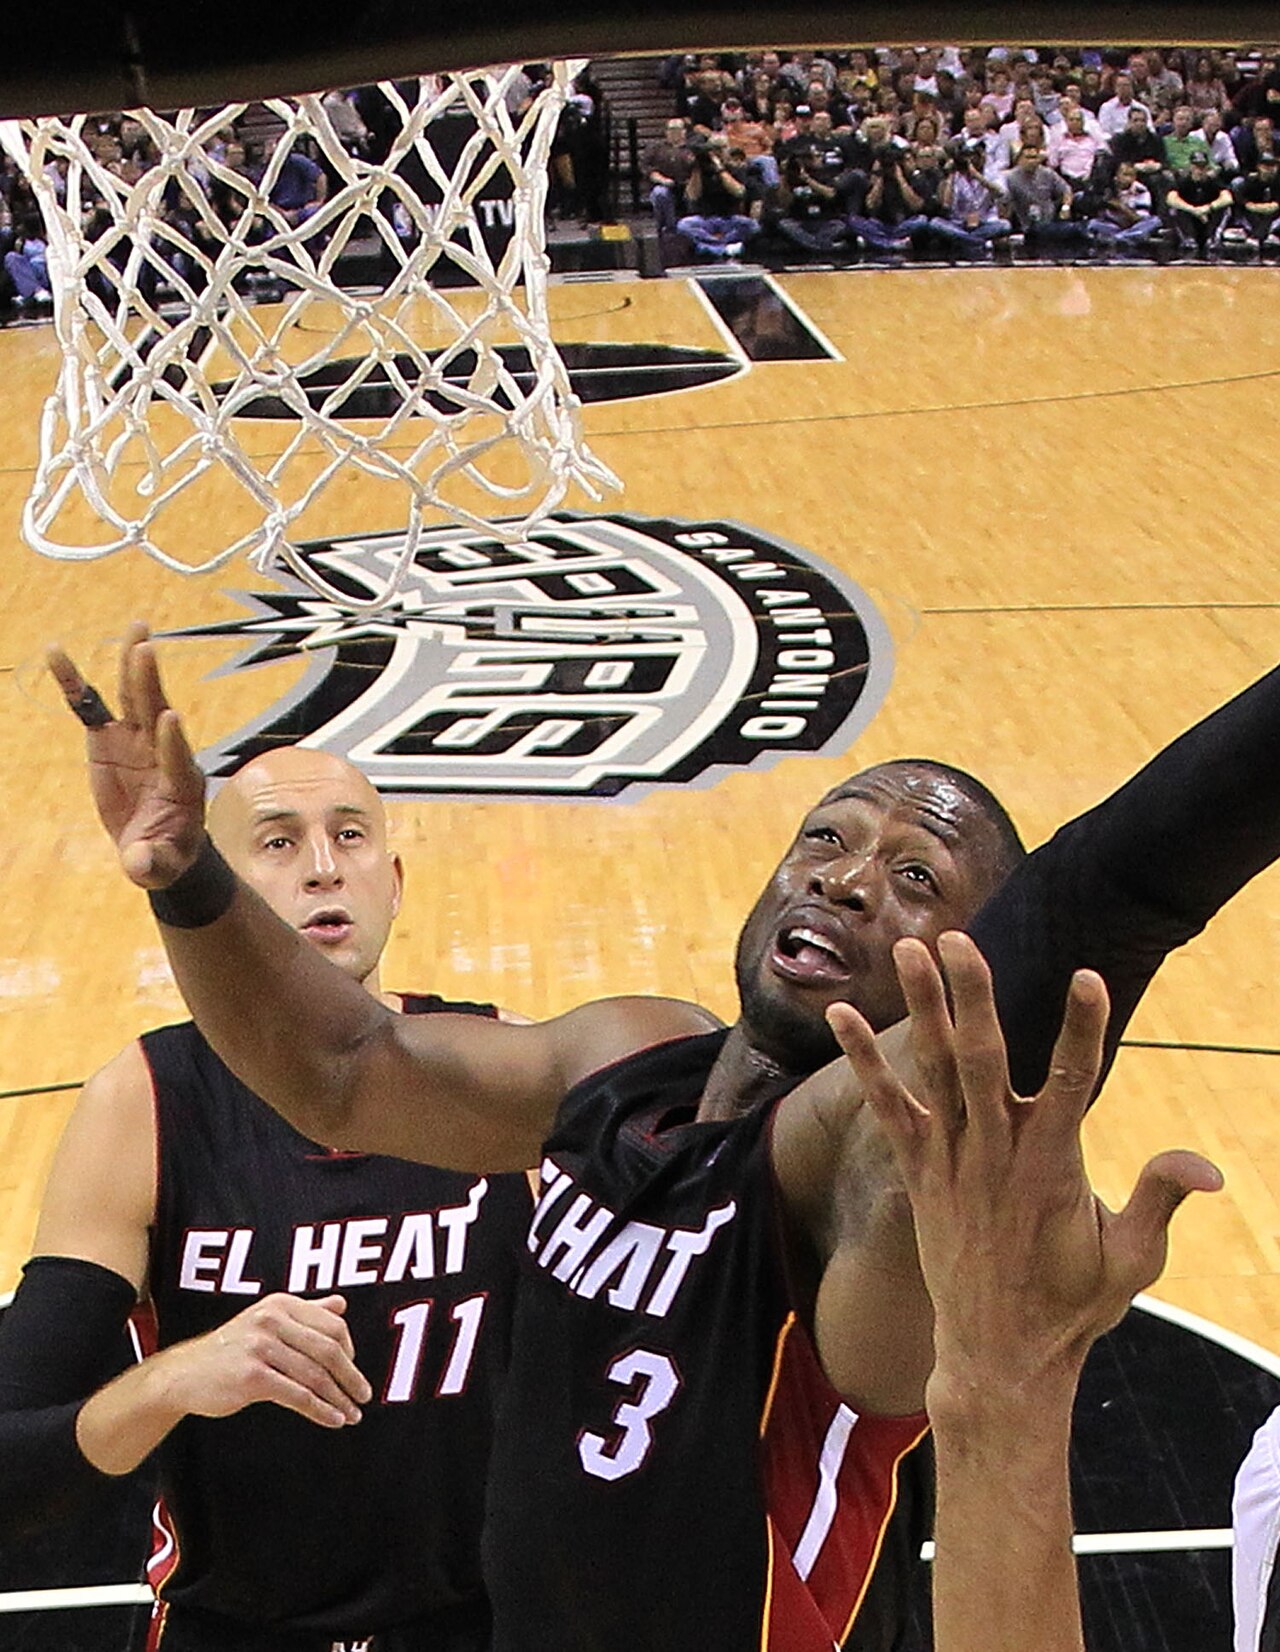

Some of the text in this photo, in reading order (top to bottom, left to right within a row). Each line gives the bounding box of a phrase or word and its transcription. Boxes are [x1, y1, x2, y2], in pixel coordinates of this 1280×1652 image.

[480, 199, 513, 226] TV
[674, 531, 836, 740] SAN ANTONIO
[179, 1175, 490, 1295] EL HEAT
[538, 1193, 737, 1318] HAT
[383, 1293, 488, 1405] 11
[577, 1346, 683, 1482] 3
